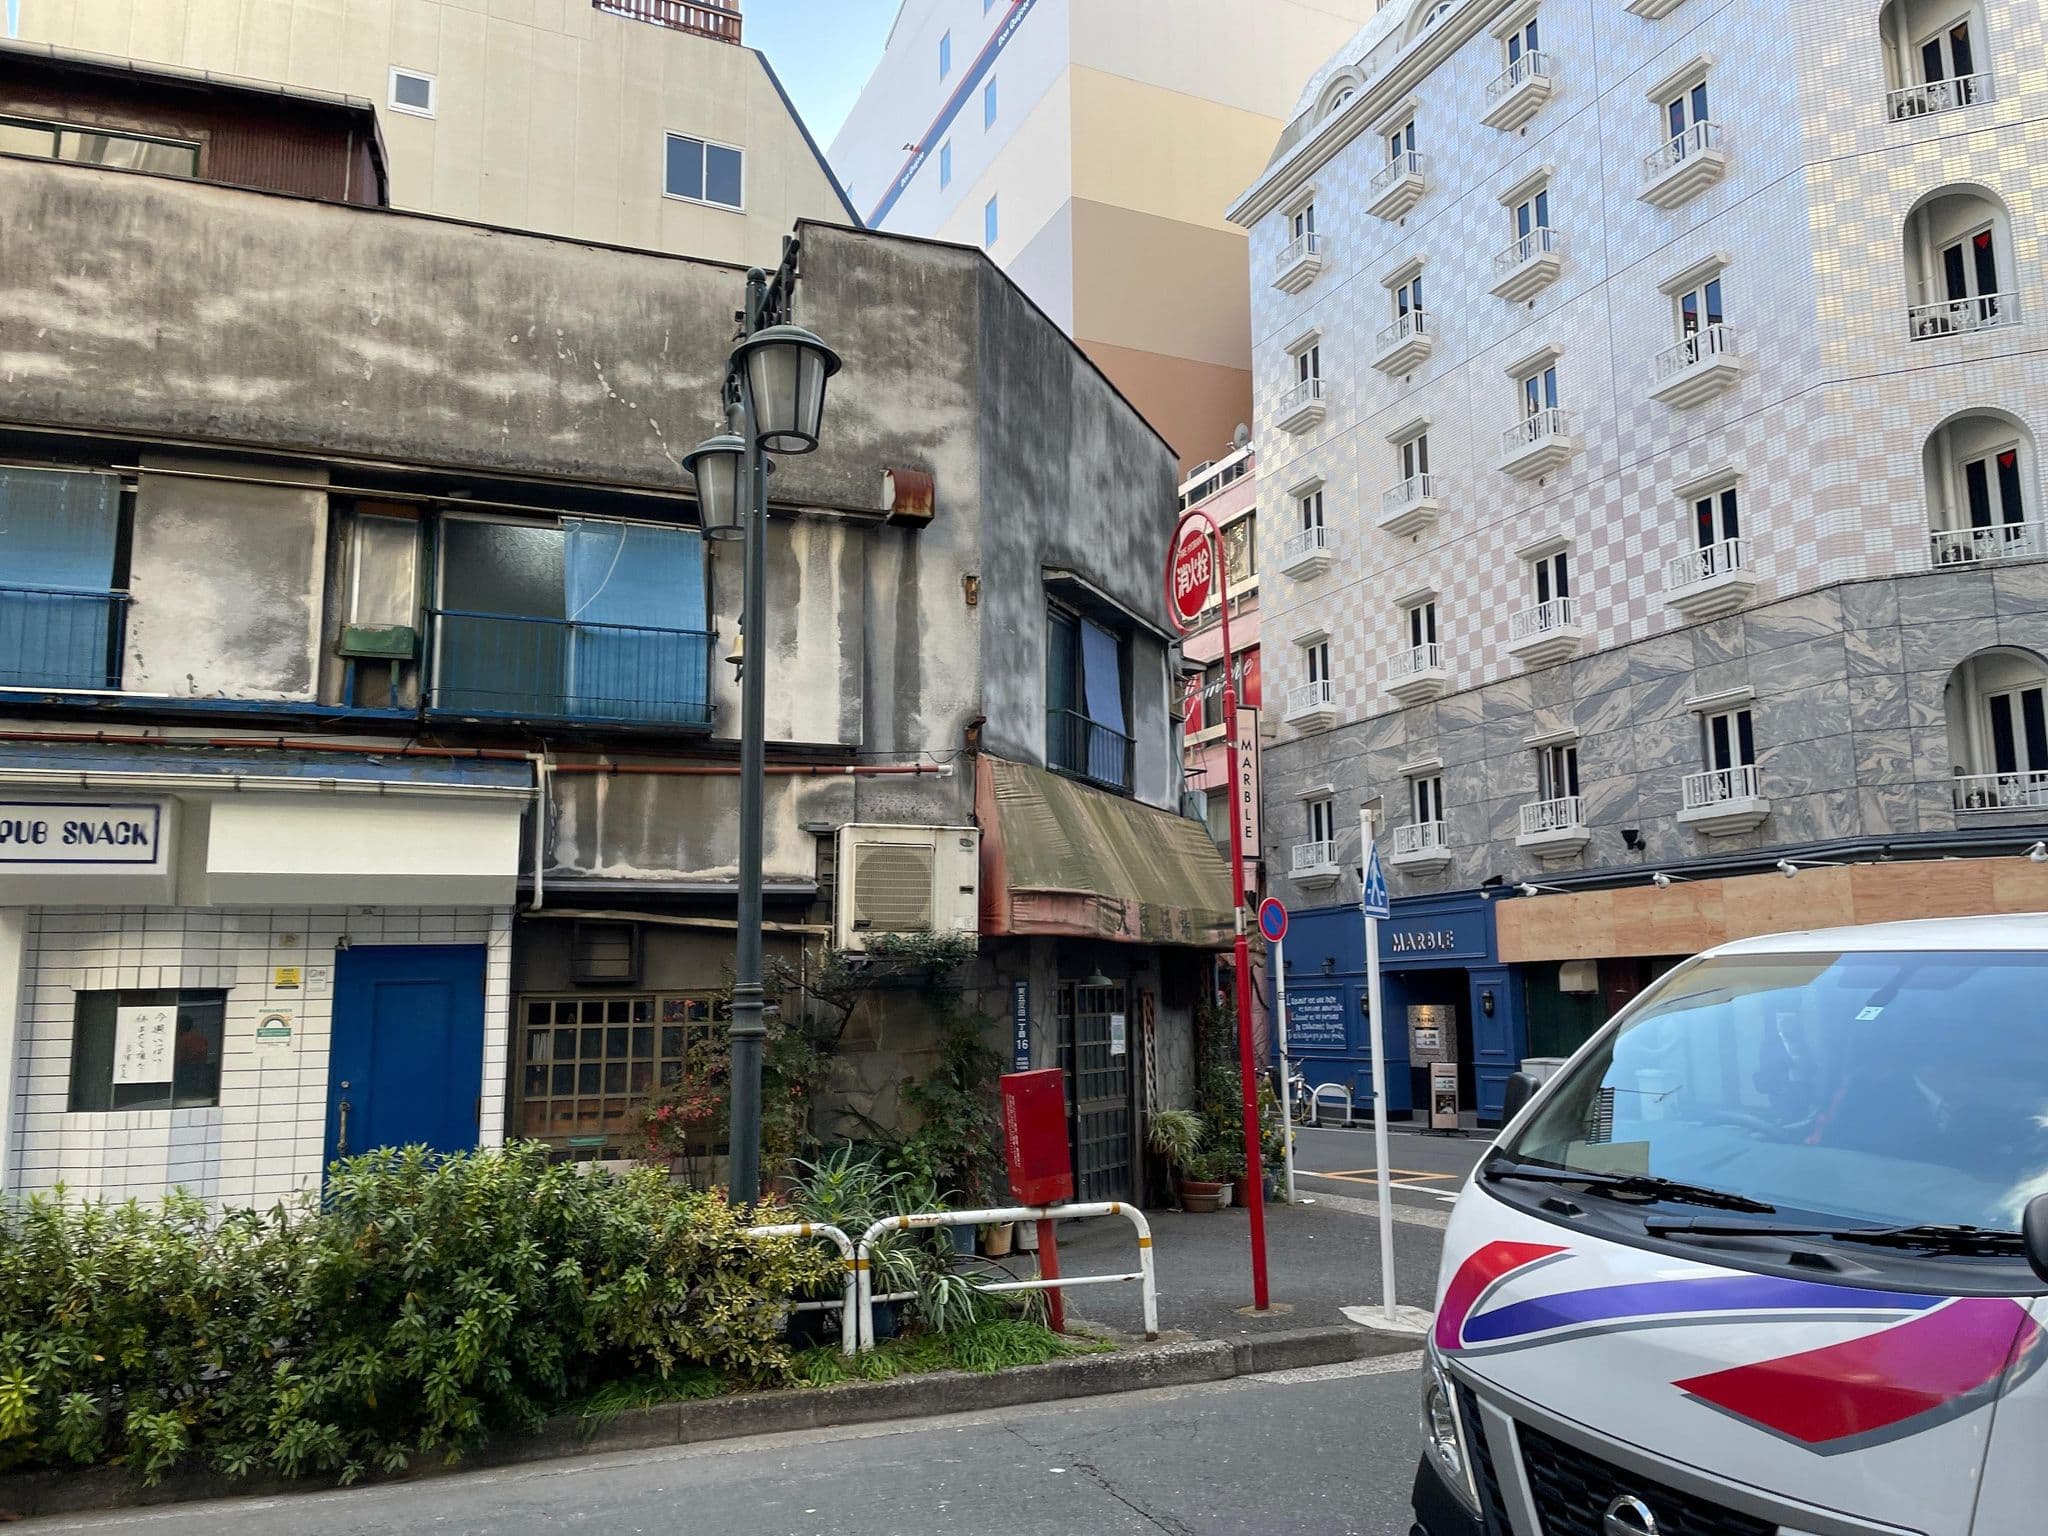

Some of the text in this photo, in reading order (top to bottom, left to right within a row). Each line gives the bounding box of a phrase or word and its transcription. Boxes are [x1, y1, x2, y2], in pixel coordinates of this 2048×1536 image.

[1177, 548, 1209, 599] 消火栓
[1241, 740, 1252, 838] MARBLE
[0, 820, 149, 845] PUB SNACK
[1393, 929, 1454, 952] MARBLE
[1016, 1039, 1029, 1050] 16
